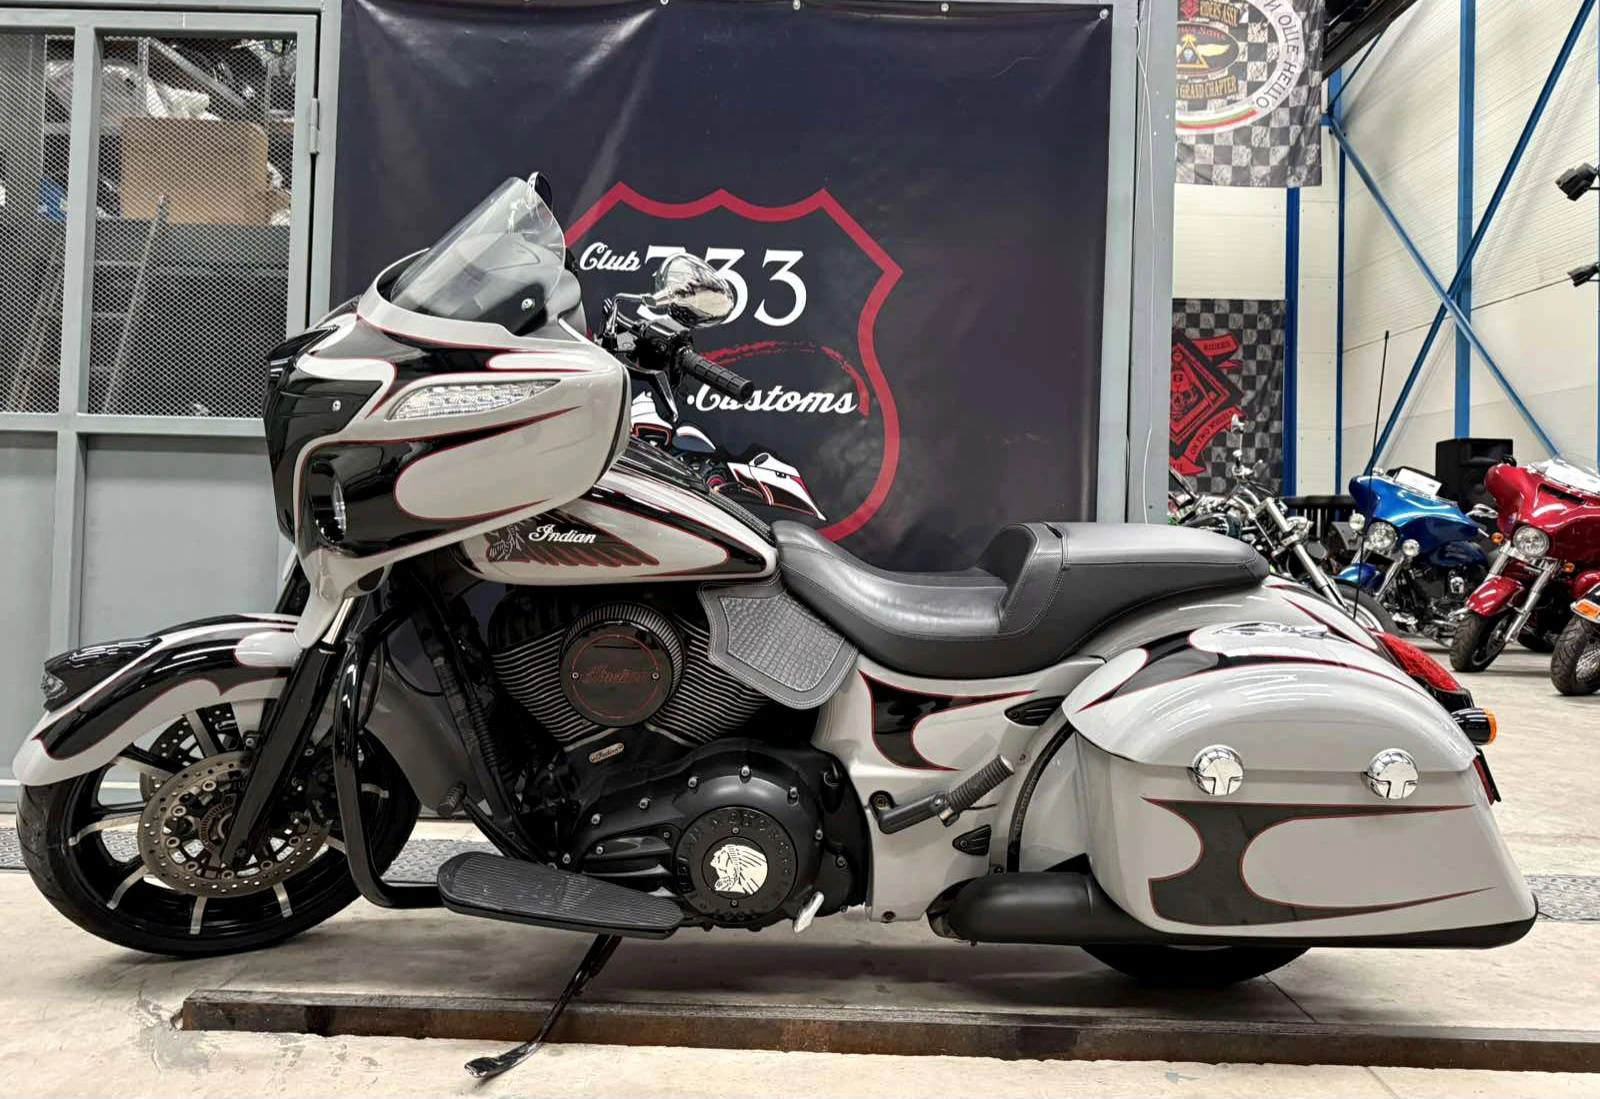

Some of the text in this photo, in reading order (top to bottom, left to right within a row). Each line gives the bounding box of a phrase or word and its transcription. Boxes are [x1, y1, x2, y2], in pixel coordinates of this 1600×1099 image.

[1204, 74, 1237, 98] CHAPTER
[579, 242, 641, 272] Club
[528, 523, 597, 544] Indian
